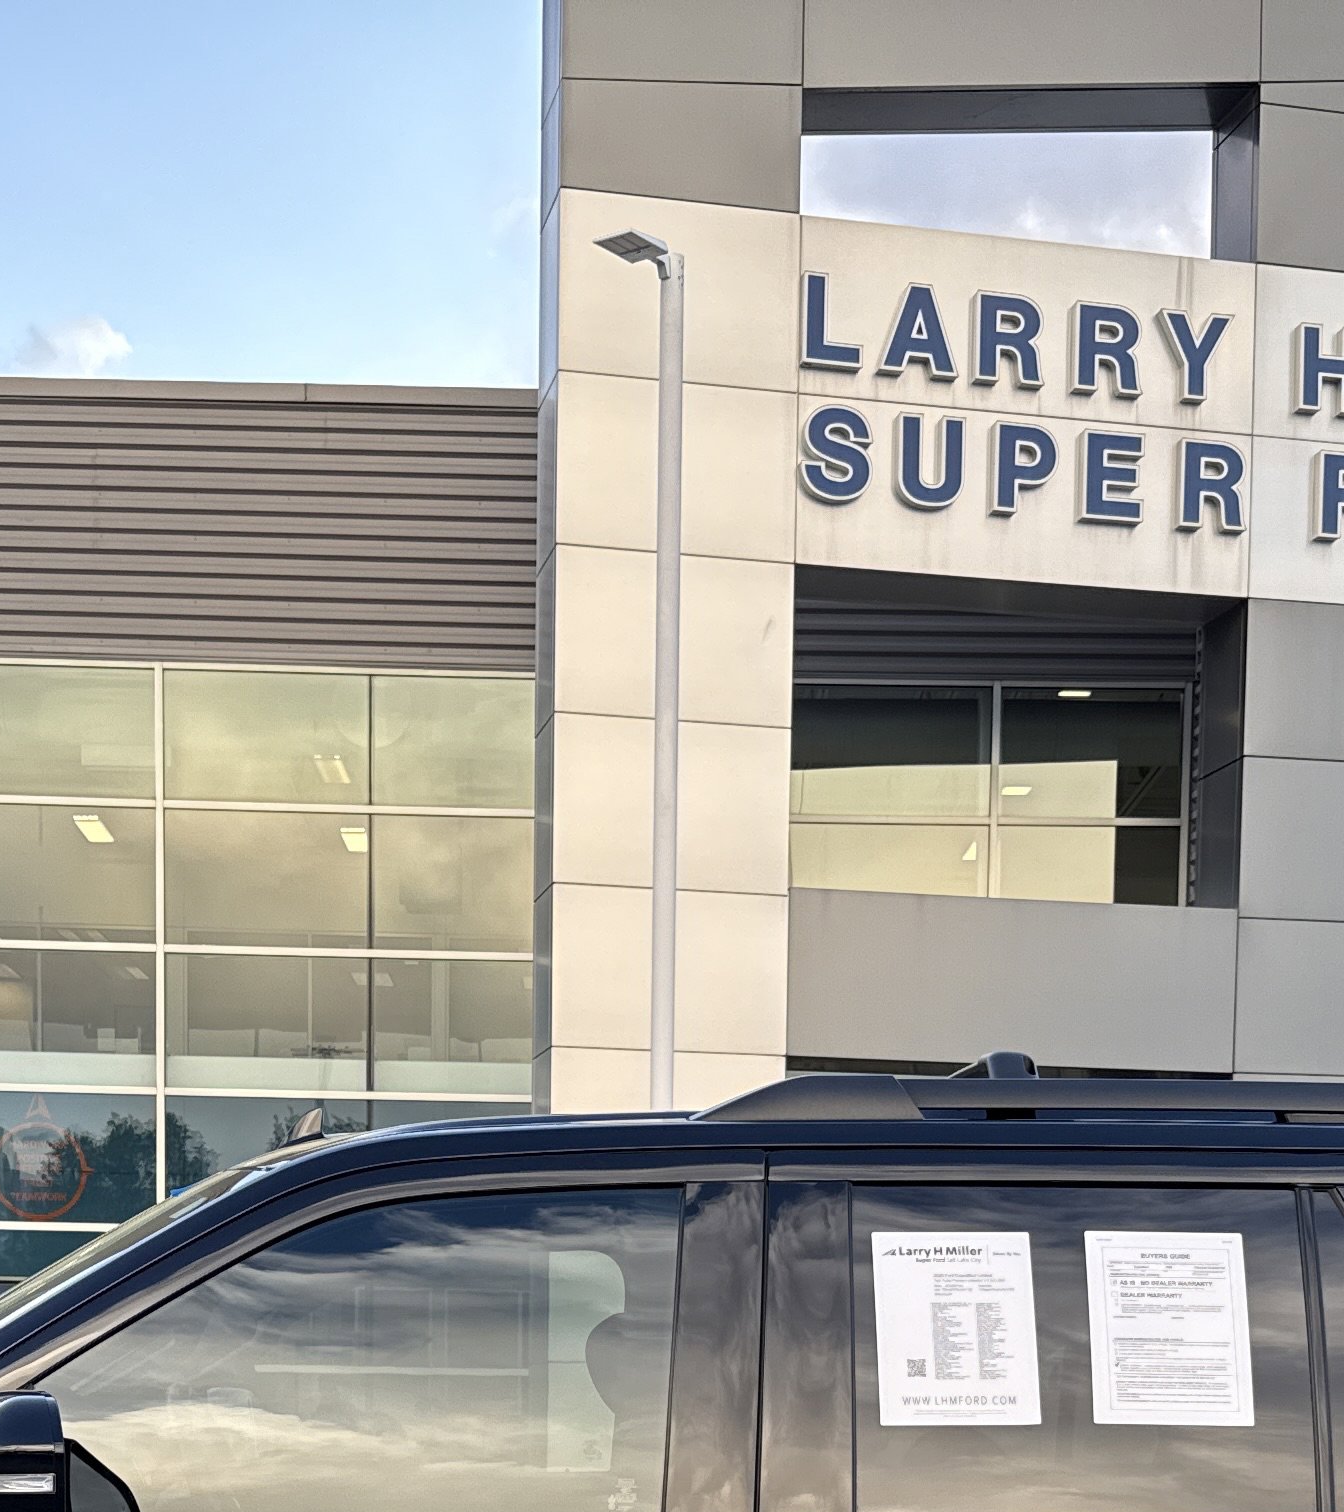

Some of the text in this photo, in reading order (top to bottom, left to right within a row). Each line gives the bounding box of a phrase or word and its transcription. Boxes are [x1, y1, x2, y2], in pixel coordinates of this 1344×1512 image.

[799, 271, 1234, 404] LARRY
[798, 404, 1249, 534] SUPER
[898, 1246, 931, 1258] Larry
[933, 1246, 943, 1256] H
[945, 1245, 983, 1256] Miller
